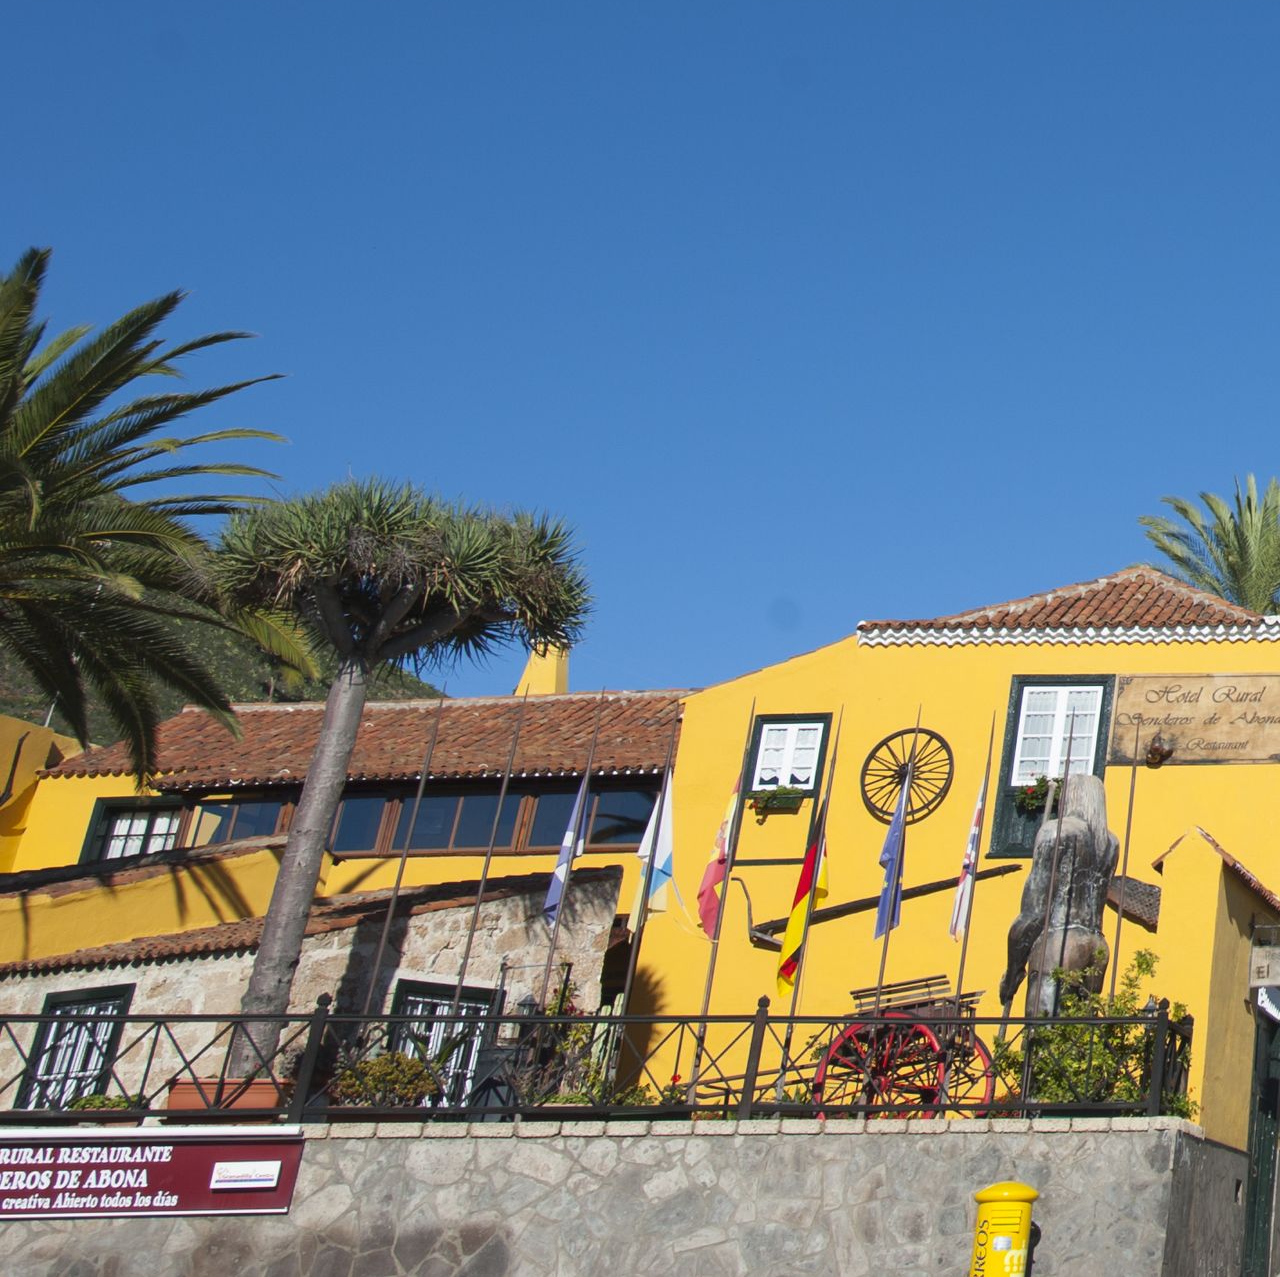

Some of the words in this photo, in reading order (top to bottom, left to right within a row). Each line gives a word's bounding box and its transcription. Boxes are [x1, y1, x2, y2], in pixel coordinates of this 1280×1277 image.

[1145, 684, 1204, 704] Hotel
[1212, 685, 1268, 704] Rural
[1116, 712, 1196, 726] Senderos
[1203, 712, 1220, 725] de
[1256, 964, 1270, 979] El
[0, 1147, 54, 1165] RURAL
[57, 1146, 174, 1164] RESTAURANTE
[0, 1170, 53, 1190] EROS
[53, 1170, 83, 1190] DE
[82, 1168, 149, 1189] ABONA
[2, 1193, 51, 1210] creativa
[52, 1192, 99, 1209] Abierto
[100, 1192, 133, 1208] todos
[133, 1192, 151, 1207] los
[152, 1191, 179, 1207] días
